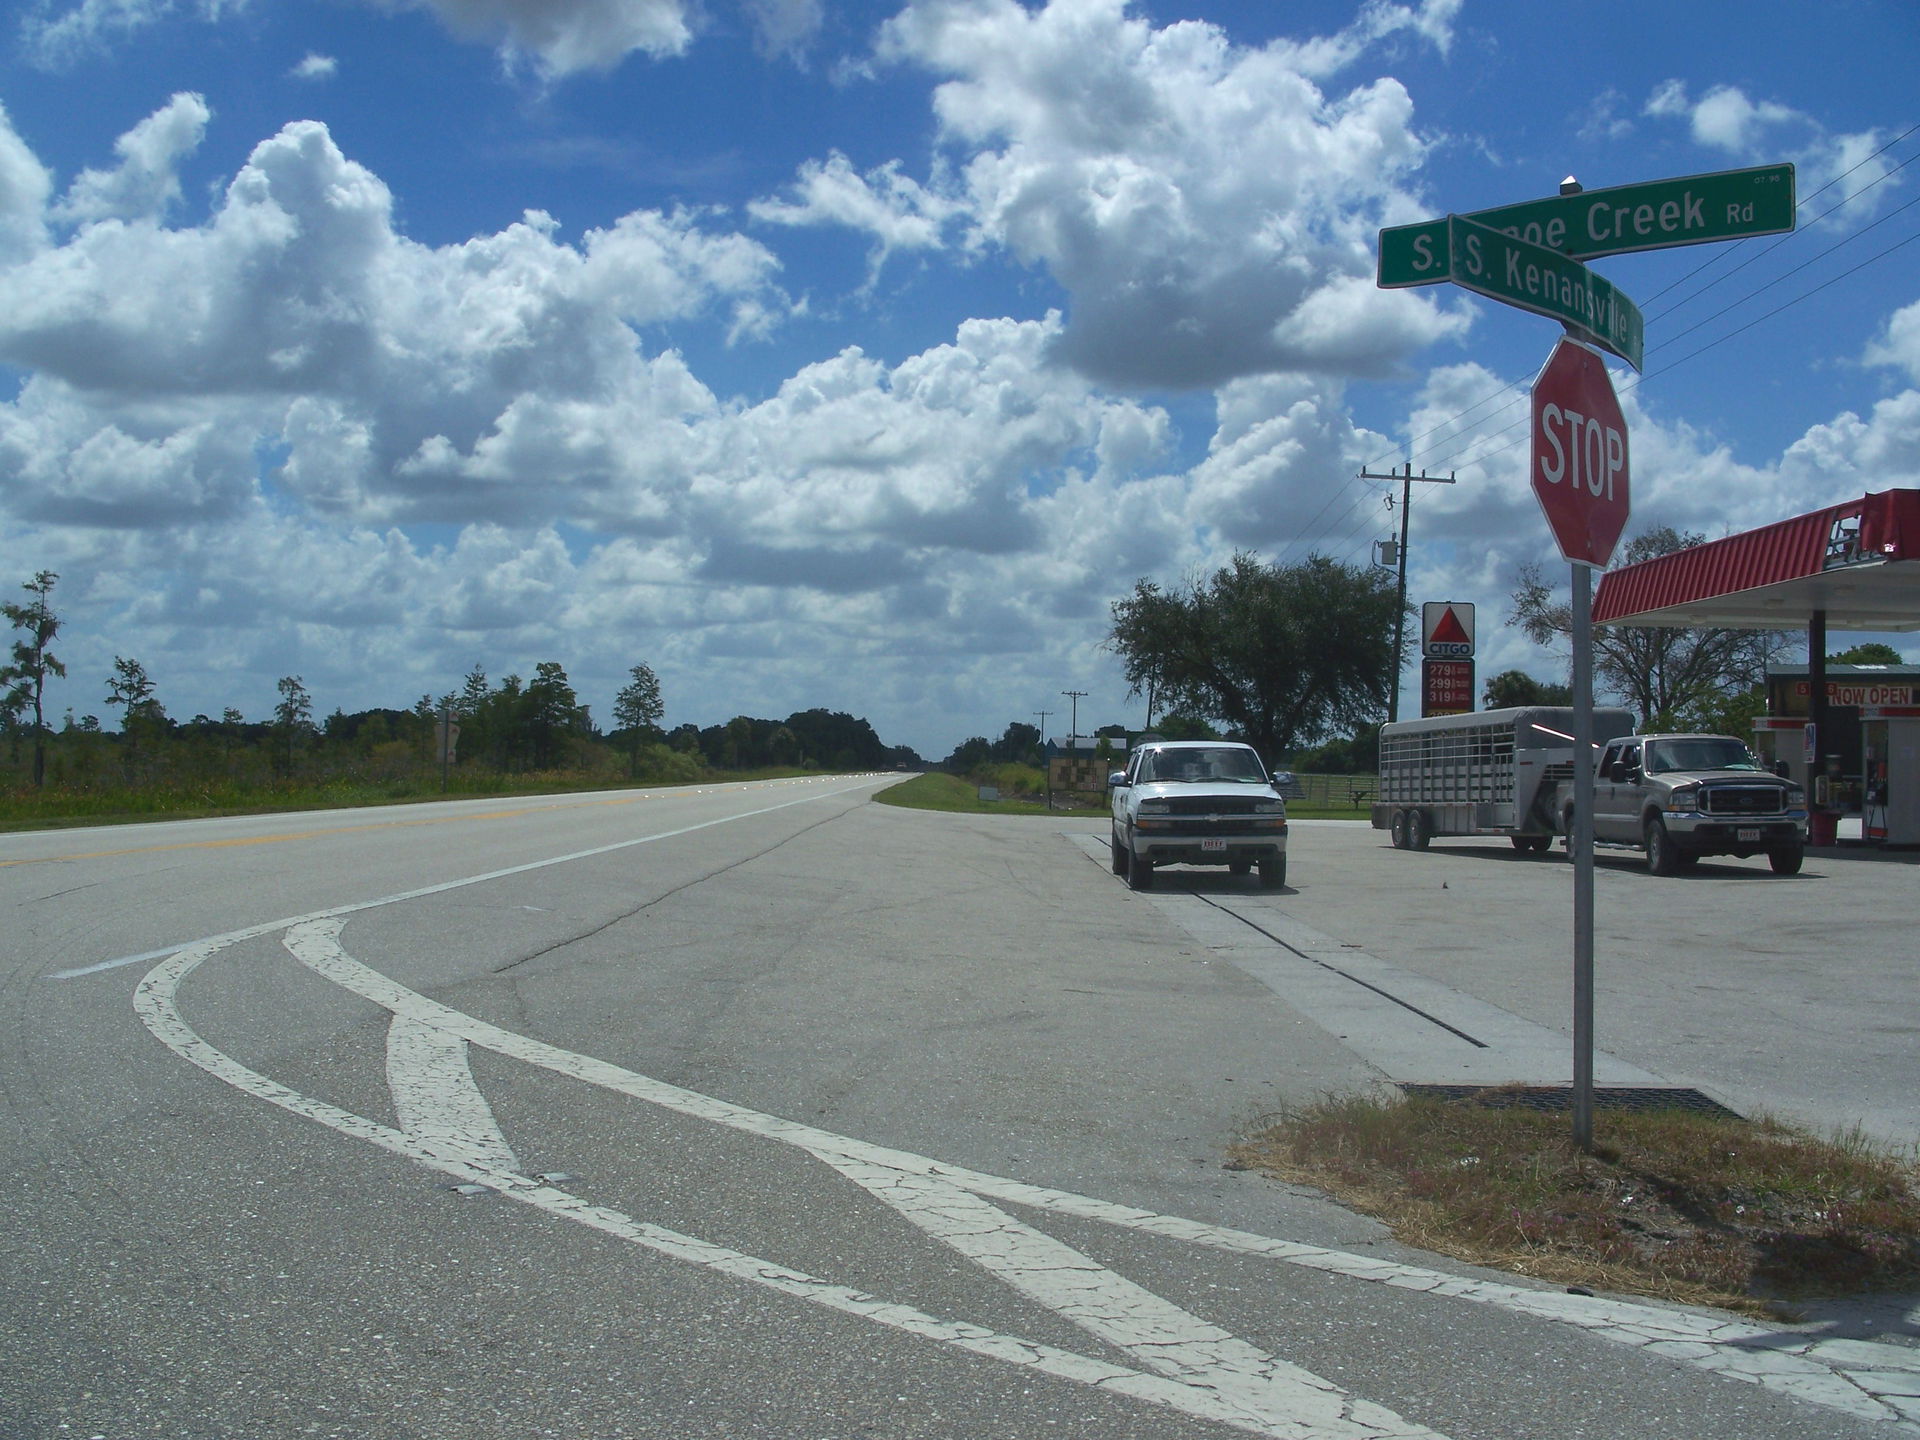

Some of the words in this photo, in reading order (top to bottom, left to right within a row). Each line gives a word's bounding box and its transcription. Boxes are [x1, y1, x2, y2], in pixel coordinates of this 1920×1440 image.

[1412, 234, 1442, 271] S.
[1588, 191, 1705, 241] Creek
[1726, 202, 1754, 225] Rd
[1466, 234, 1492, 280] S.
[1506, 247, 1627, 343] Kenansville
[1541, 402, 1623, 501] STOP
[1430, 643, 1470, 654] CITGO
[1832, 688, 1865, 705] NOW
[1869, 687, 1909, 705] OPEN
